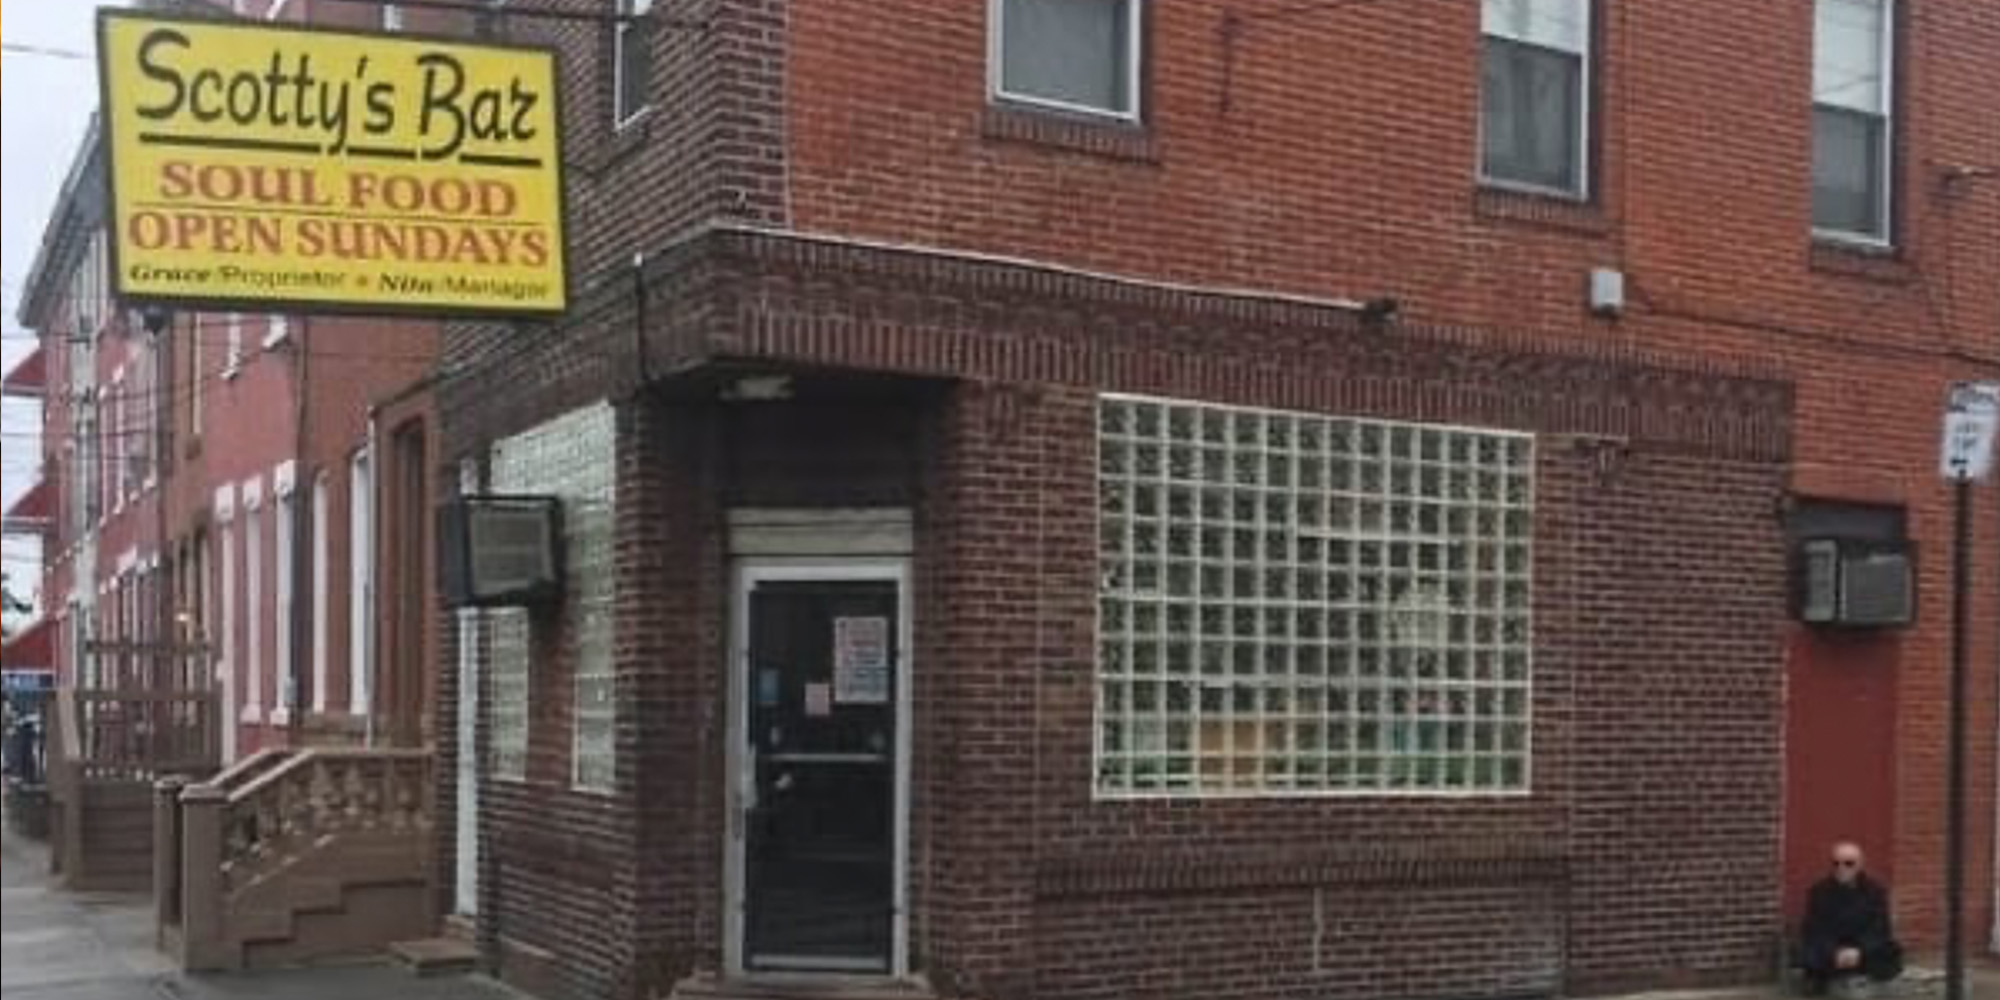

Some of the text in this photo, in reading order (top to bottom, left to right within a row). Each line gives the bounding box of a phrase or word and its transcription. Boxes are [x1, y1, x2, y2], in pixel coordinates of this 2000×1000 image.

[136, 28, 539, 160] Scotty's Bar
[160, 161, 517, 218] SOUL FOOD
[129, 212, 549, 268] OPEN SUNDAYS
